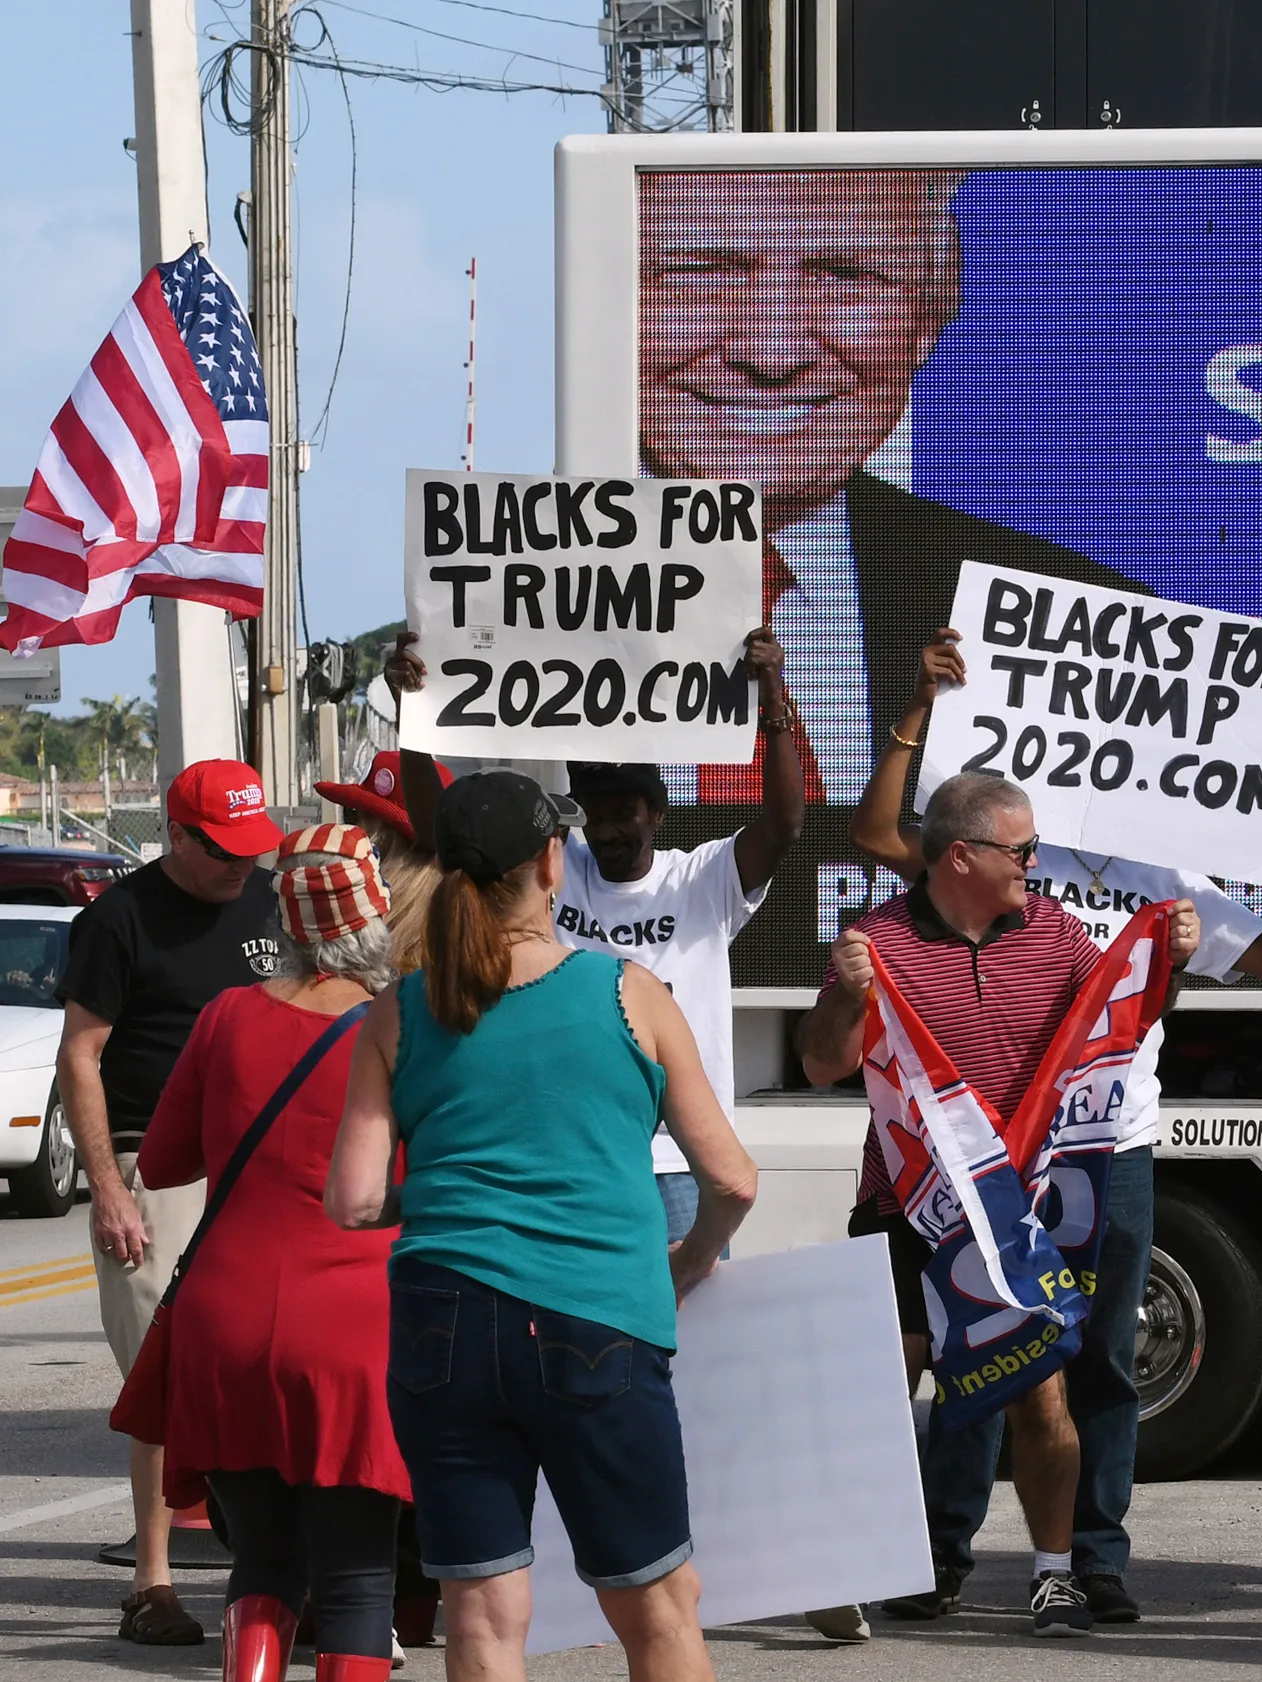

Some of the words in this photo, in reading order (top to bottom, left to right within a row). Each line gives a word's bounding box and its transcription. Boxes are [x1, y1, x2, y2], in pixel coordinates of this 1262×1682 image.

[423, 480, 638, 556] BLACKS
[659, 483, 758, 549] FOR
[429, 563, 705, 632] TRUMP
[983, 578, 1204, 671] BLACKS
[435, 658, 749, 727] 2020.COM
[990, 654, 1240, 745] TRUMP
[225, 789, 262, 803] Trump
[241, 939, 260, 958] ZZ
[556, 903, 677, 947] BLACKS
[261, 958, 274, 972] 50
